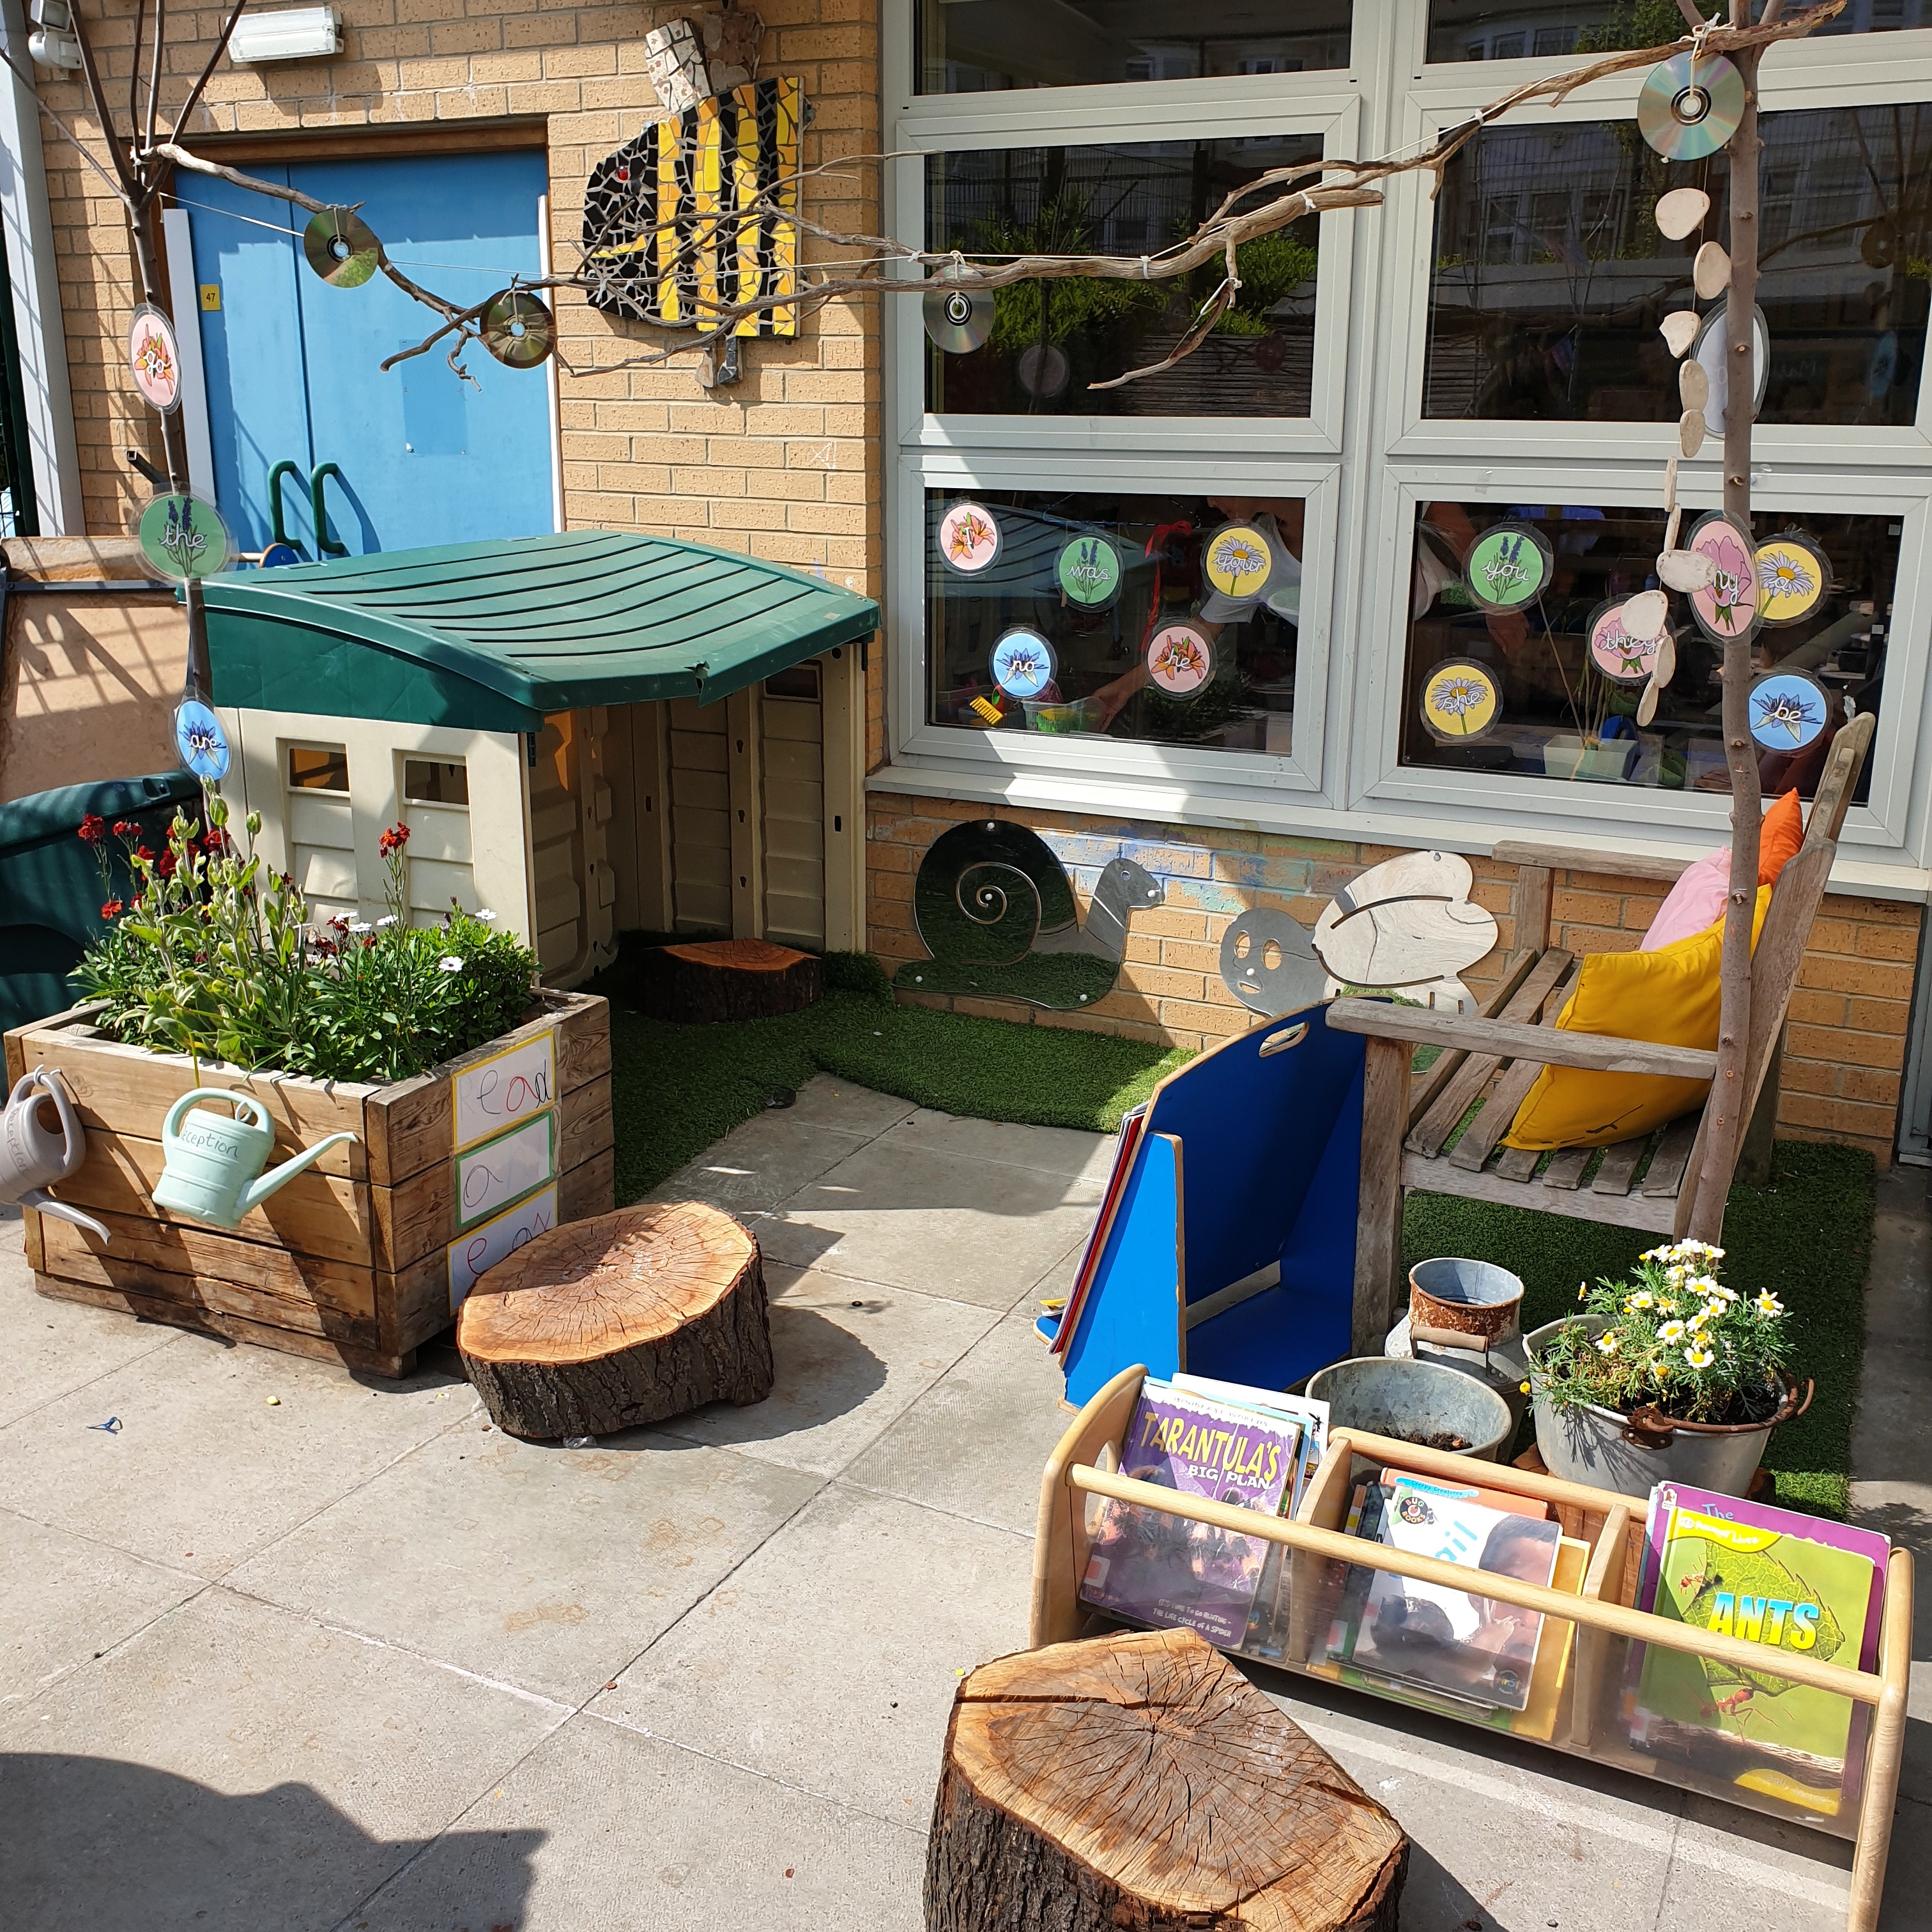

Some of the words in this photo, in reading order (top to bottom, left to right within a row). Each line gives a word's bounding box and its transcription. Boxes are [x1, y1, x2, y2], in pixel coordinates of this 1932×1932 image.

[206, 293, 215, 302] 47
[142, 351, 167, 375] go
[160, 524, 208, 549] the
[964, 526, 972, 545] I
[1066, 565, 1112, 581] was
[1212, 553, 1266, 573] your
[1481, 560, 1529, 582] you
[1767, 576, 1791, 592] a
[1601, 629, 1657, 655] they
[1009, 659, 1036, 672] no
[1163, 647, 1192, 670] he
[1439, 687, 1483, 710] she
[1768, 699, 1802, 724] be
[188, 734, 220, 753] are
[1140, 1411, 1282, 1482] TARANTULA'S
[1188, 1464, 1219, 1482] BIG
[1225, 1471, 1271, 1491] PLAN
[1411, 1480, 1432, 1491] Creepy
[1434, 1486, 1463, 1496] Creatures
[1405, 1497, 1425, 1508] BUG
[1701, 1503, 1735, 1520] The
[1401, 1510, 1426, 1523] BOOKS
[1707, 1591, 1820, 1650] ANTS
